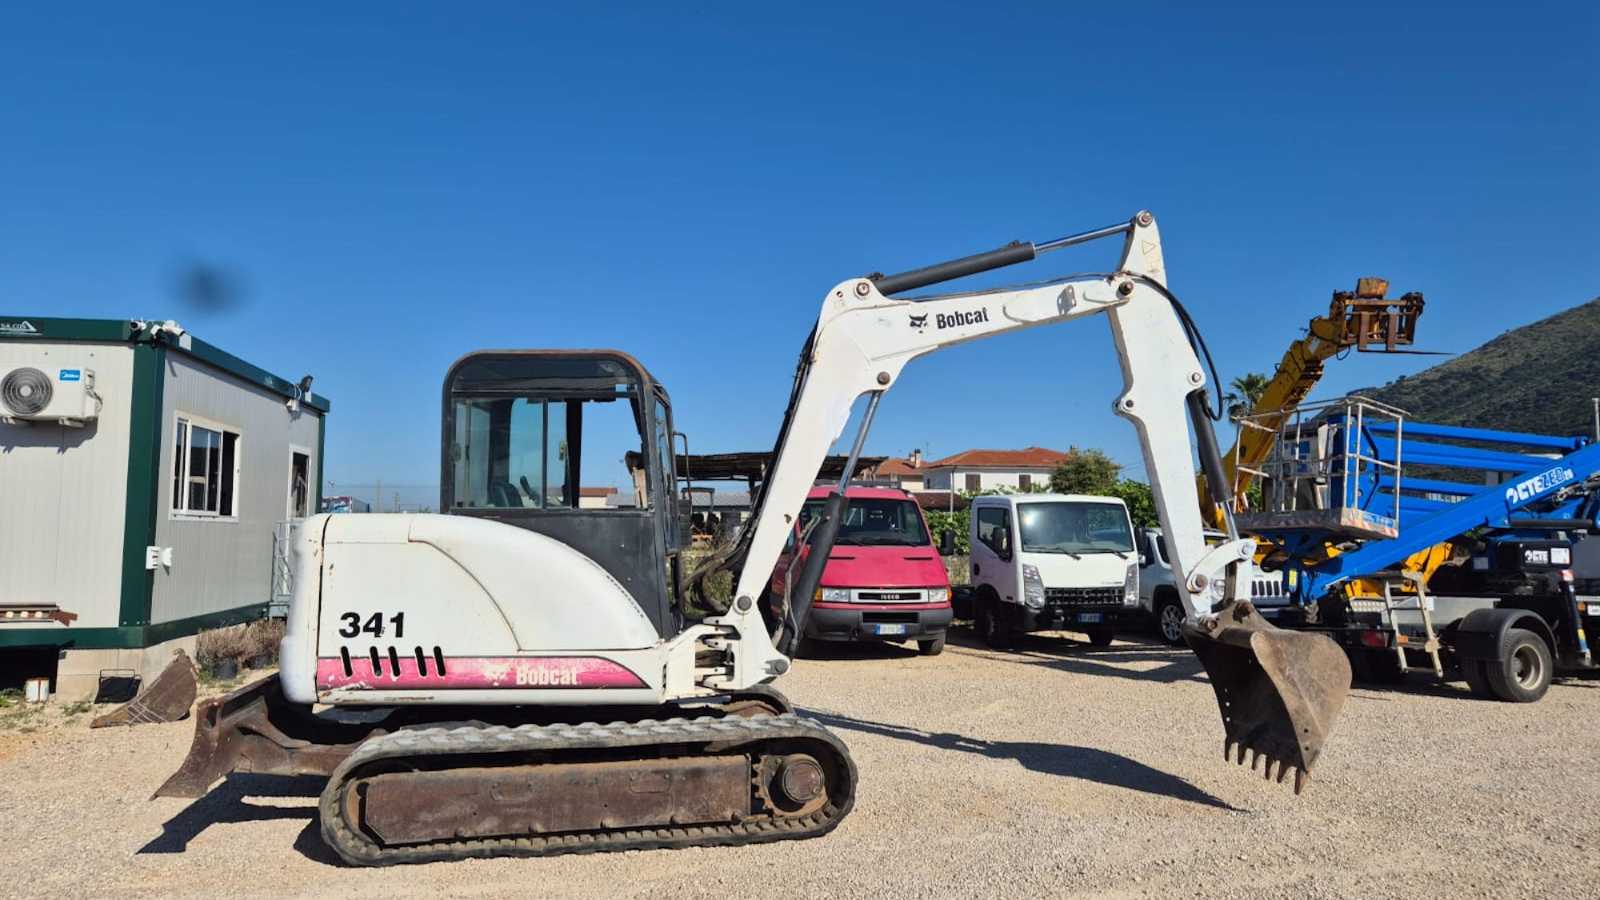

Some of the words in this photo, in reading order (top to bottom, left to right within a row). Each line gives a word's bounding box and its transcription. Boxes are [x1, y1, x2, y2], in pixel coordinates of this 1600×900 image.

[936, 307, 989, 329] Bobcat
[339, 611, 404, 638] 341
[515, 665, 577, 685] Bobcat
